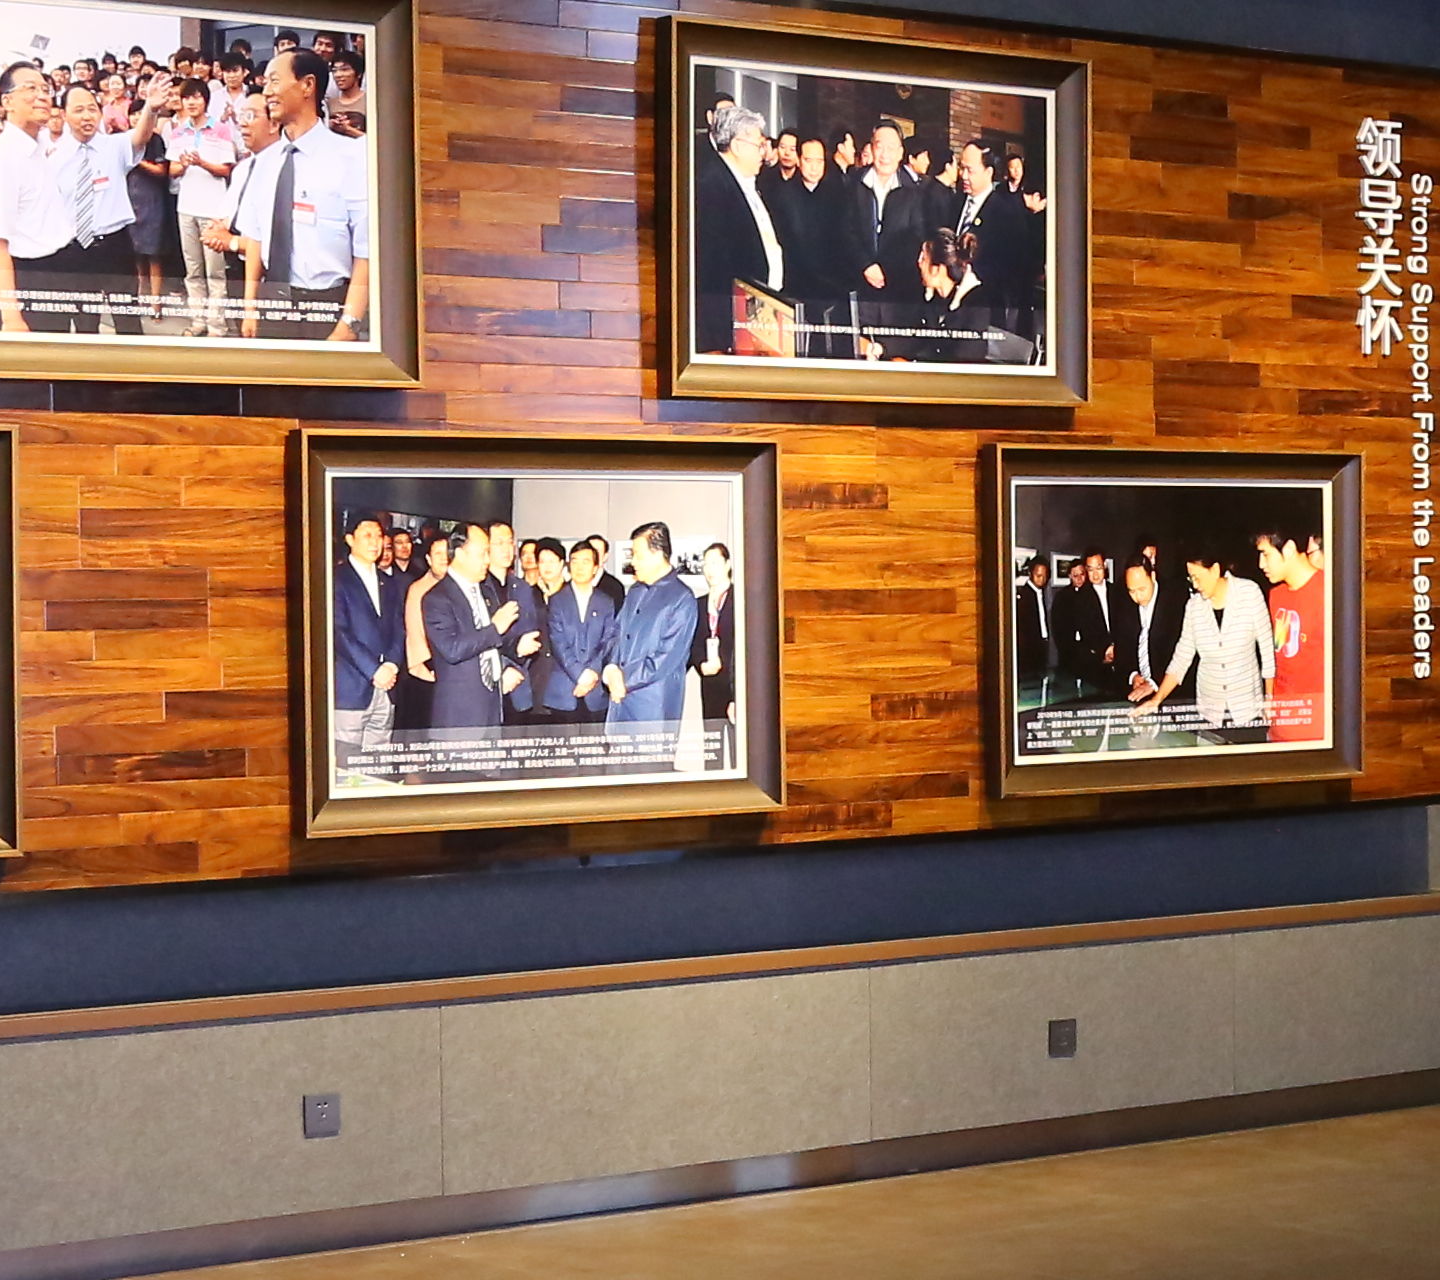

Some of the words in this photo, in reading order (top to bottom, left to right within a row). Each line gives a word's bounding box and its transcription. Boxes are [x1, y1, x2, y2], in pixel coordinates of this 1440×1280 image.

[1355, 117, 1404, 356] 领导关怀
[1407, 173, 1433, 274] Strong
[1408, 282, 1433, 402] Support
[1412, 412, 1435, 490] From
[1412, 499, 1435, 547] the
[1412, 557, 1435, 679] Leaders
